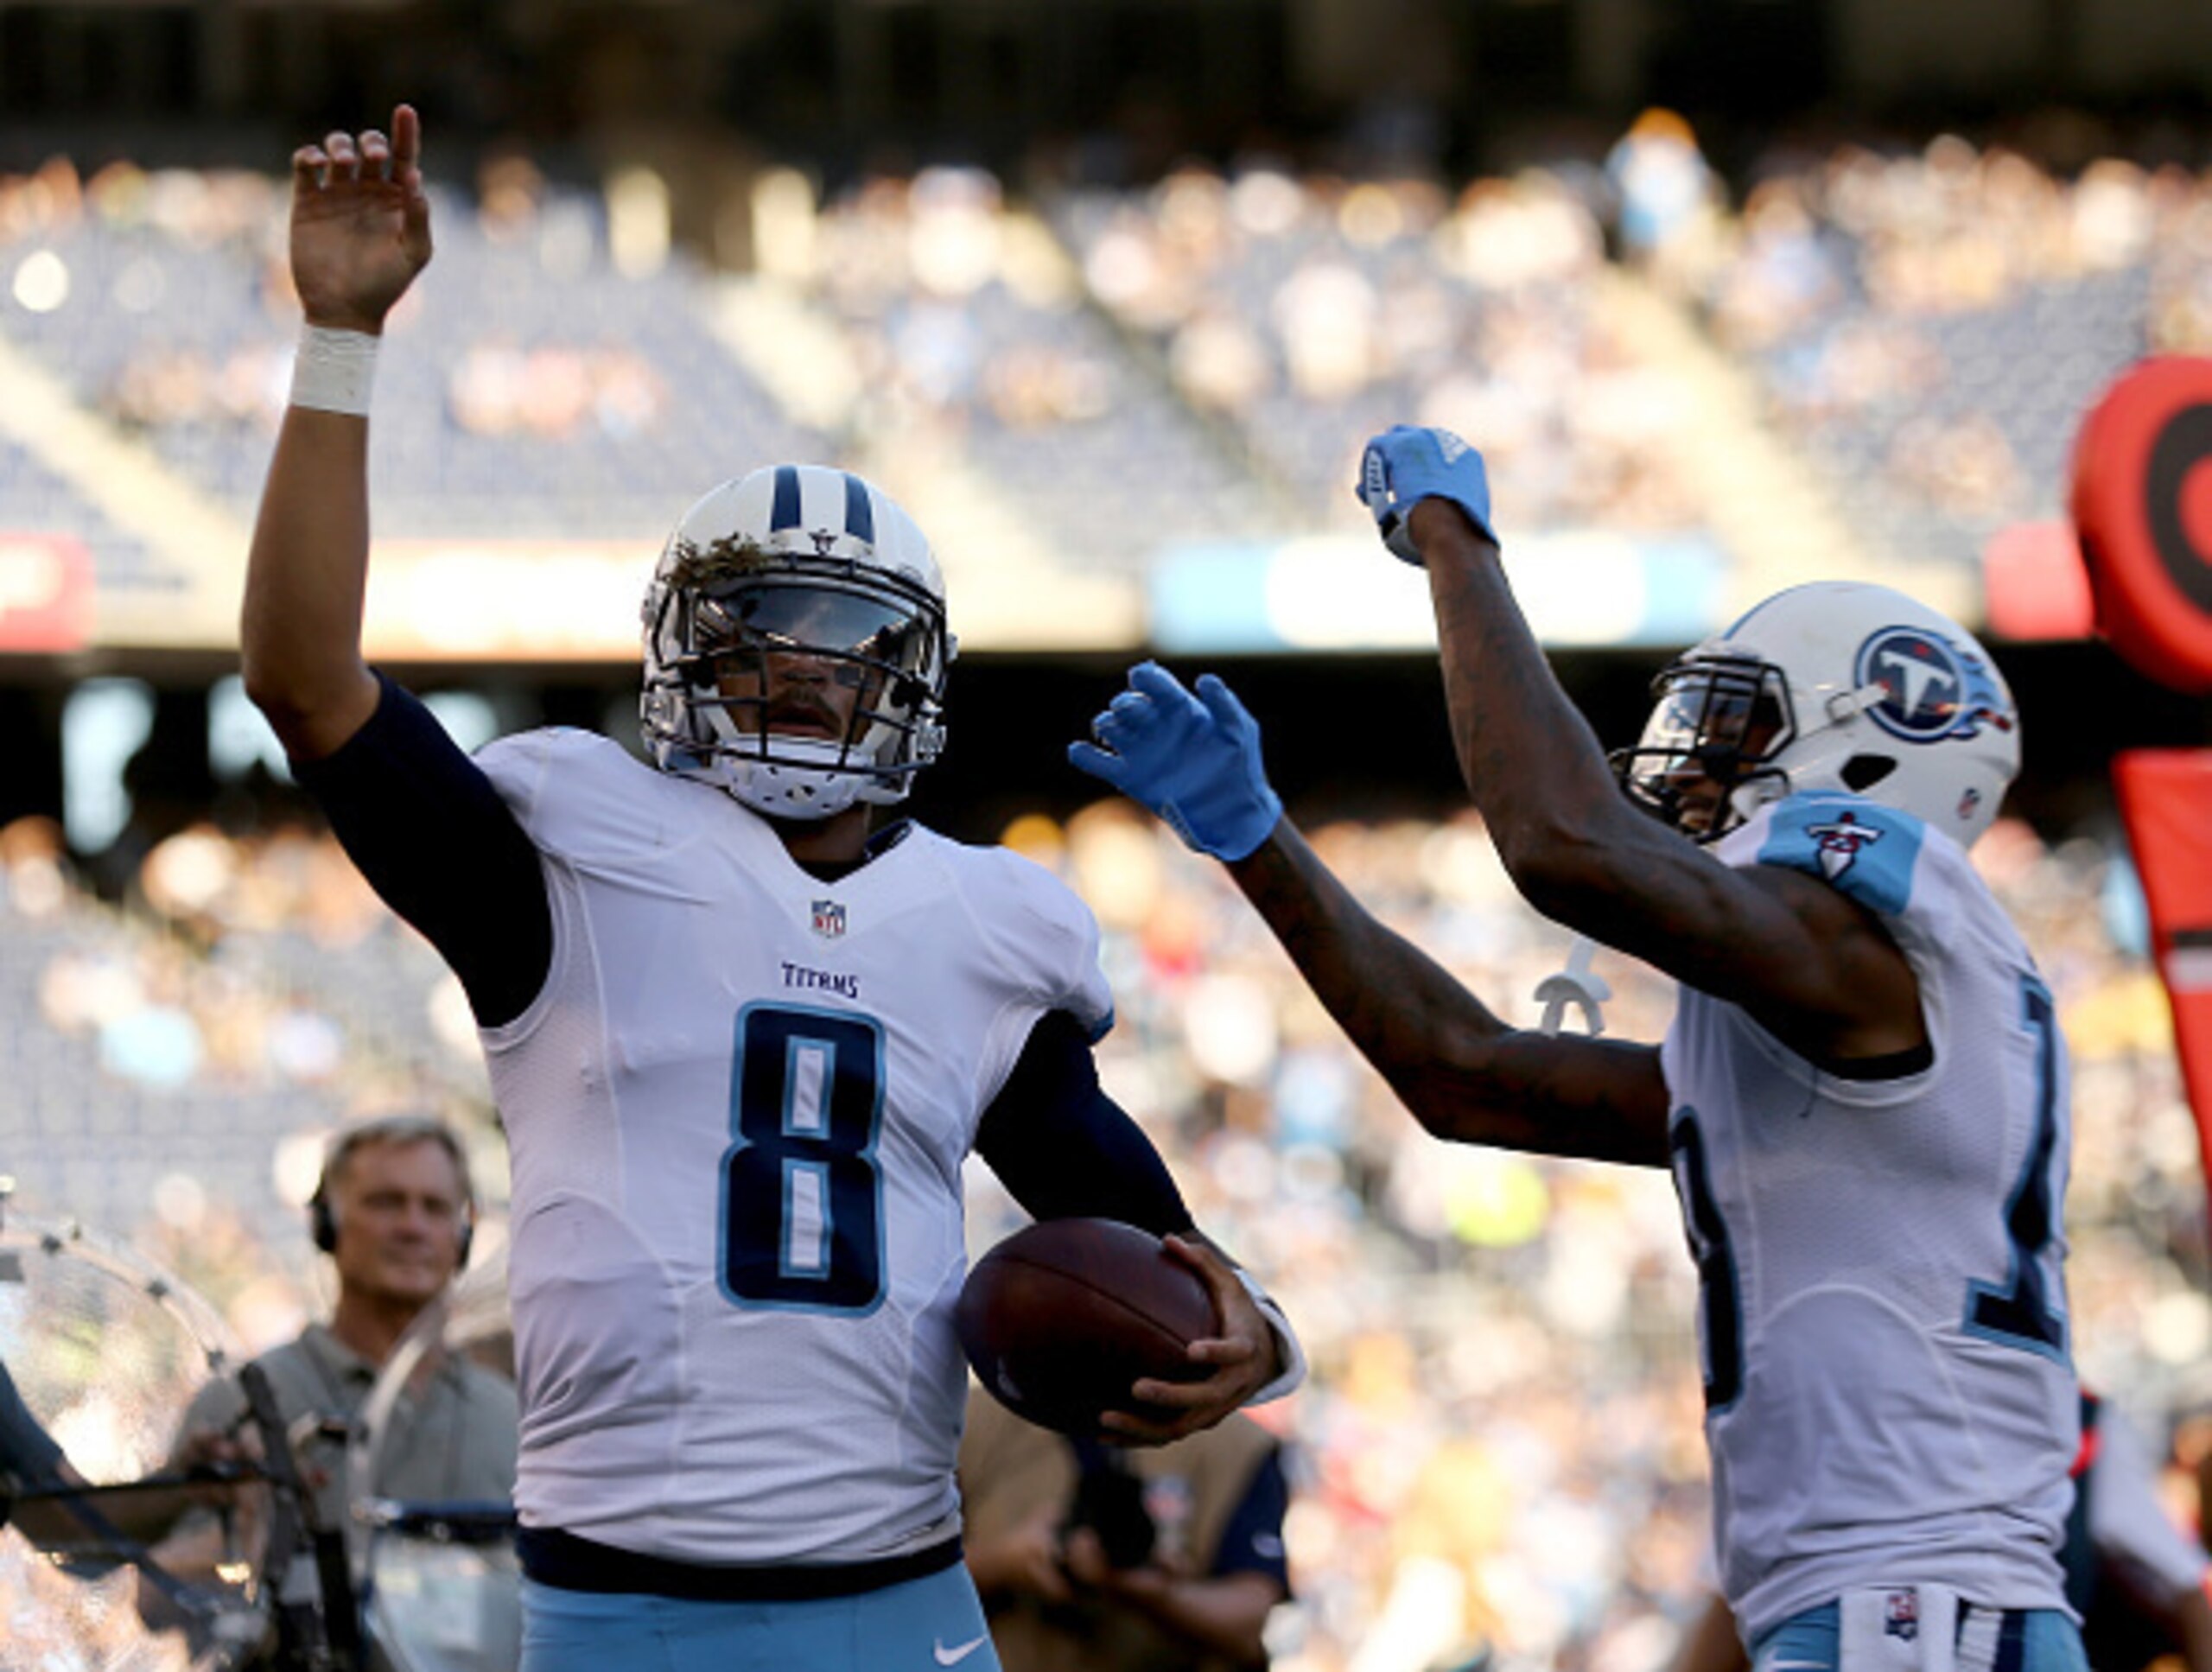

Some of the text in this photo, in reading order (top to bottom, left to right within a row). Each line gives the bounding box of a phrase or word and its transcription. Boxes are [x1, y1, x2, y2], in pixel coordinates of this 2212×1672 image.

[1878, 650, 1956, 721] T
[814, 913, 842, 934] NFL
[781, 960, 859, 999] TITANS
[715, 998, 890, 1319] 8
